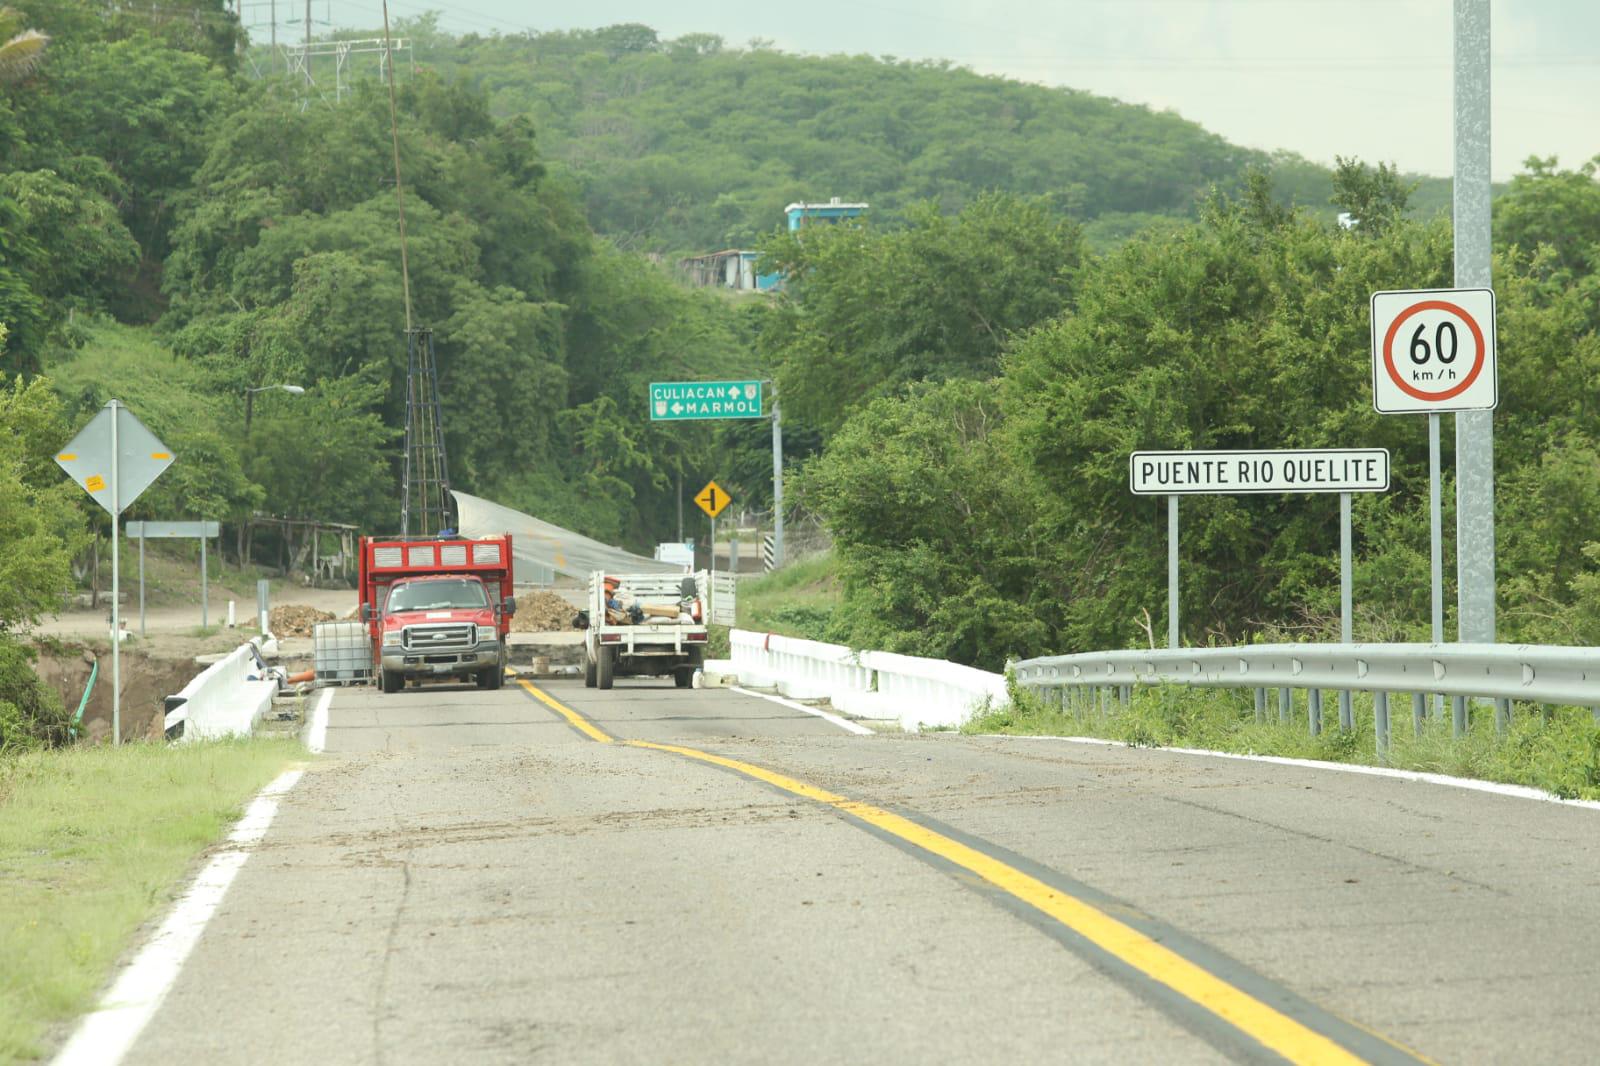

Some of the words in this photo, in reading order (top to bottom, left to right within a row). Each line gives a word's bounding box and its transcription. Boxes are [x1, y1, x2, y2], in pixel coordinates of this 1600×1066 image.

[1409, 321, 1458, 365] 60
[1412, 368, 1456, 381] km/h
[654, 387, 725, 400] CULIACAN
[686, 401, 758, 414] MARMOL
[1142, 461, 1229, 485] PUENTE
[1238, 460, 1274, 483] RIO
[1283, 459, 1378, 483] QUELITE
